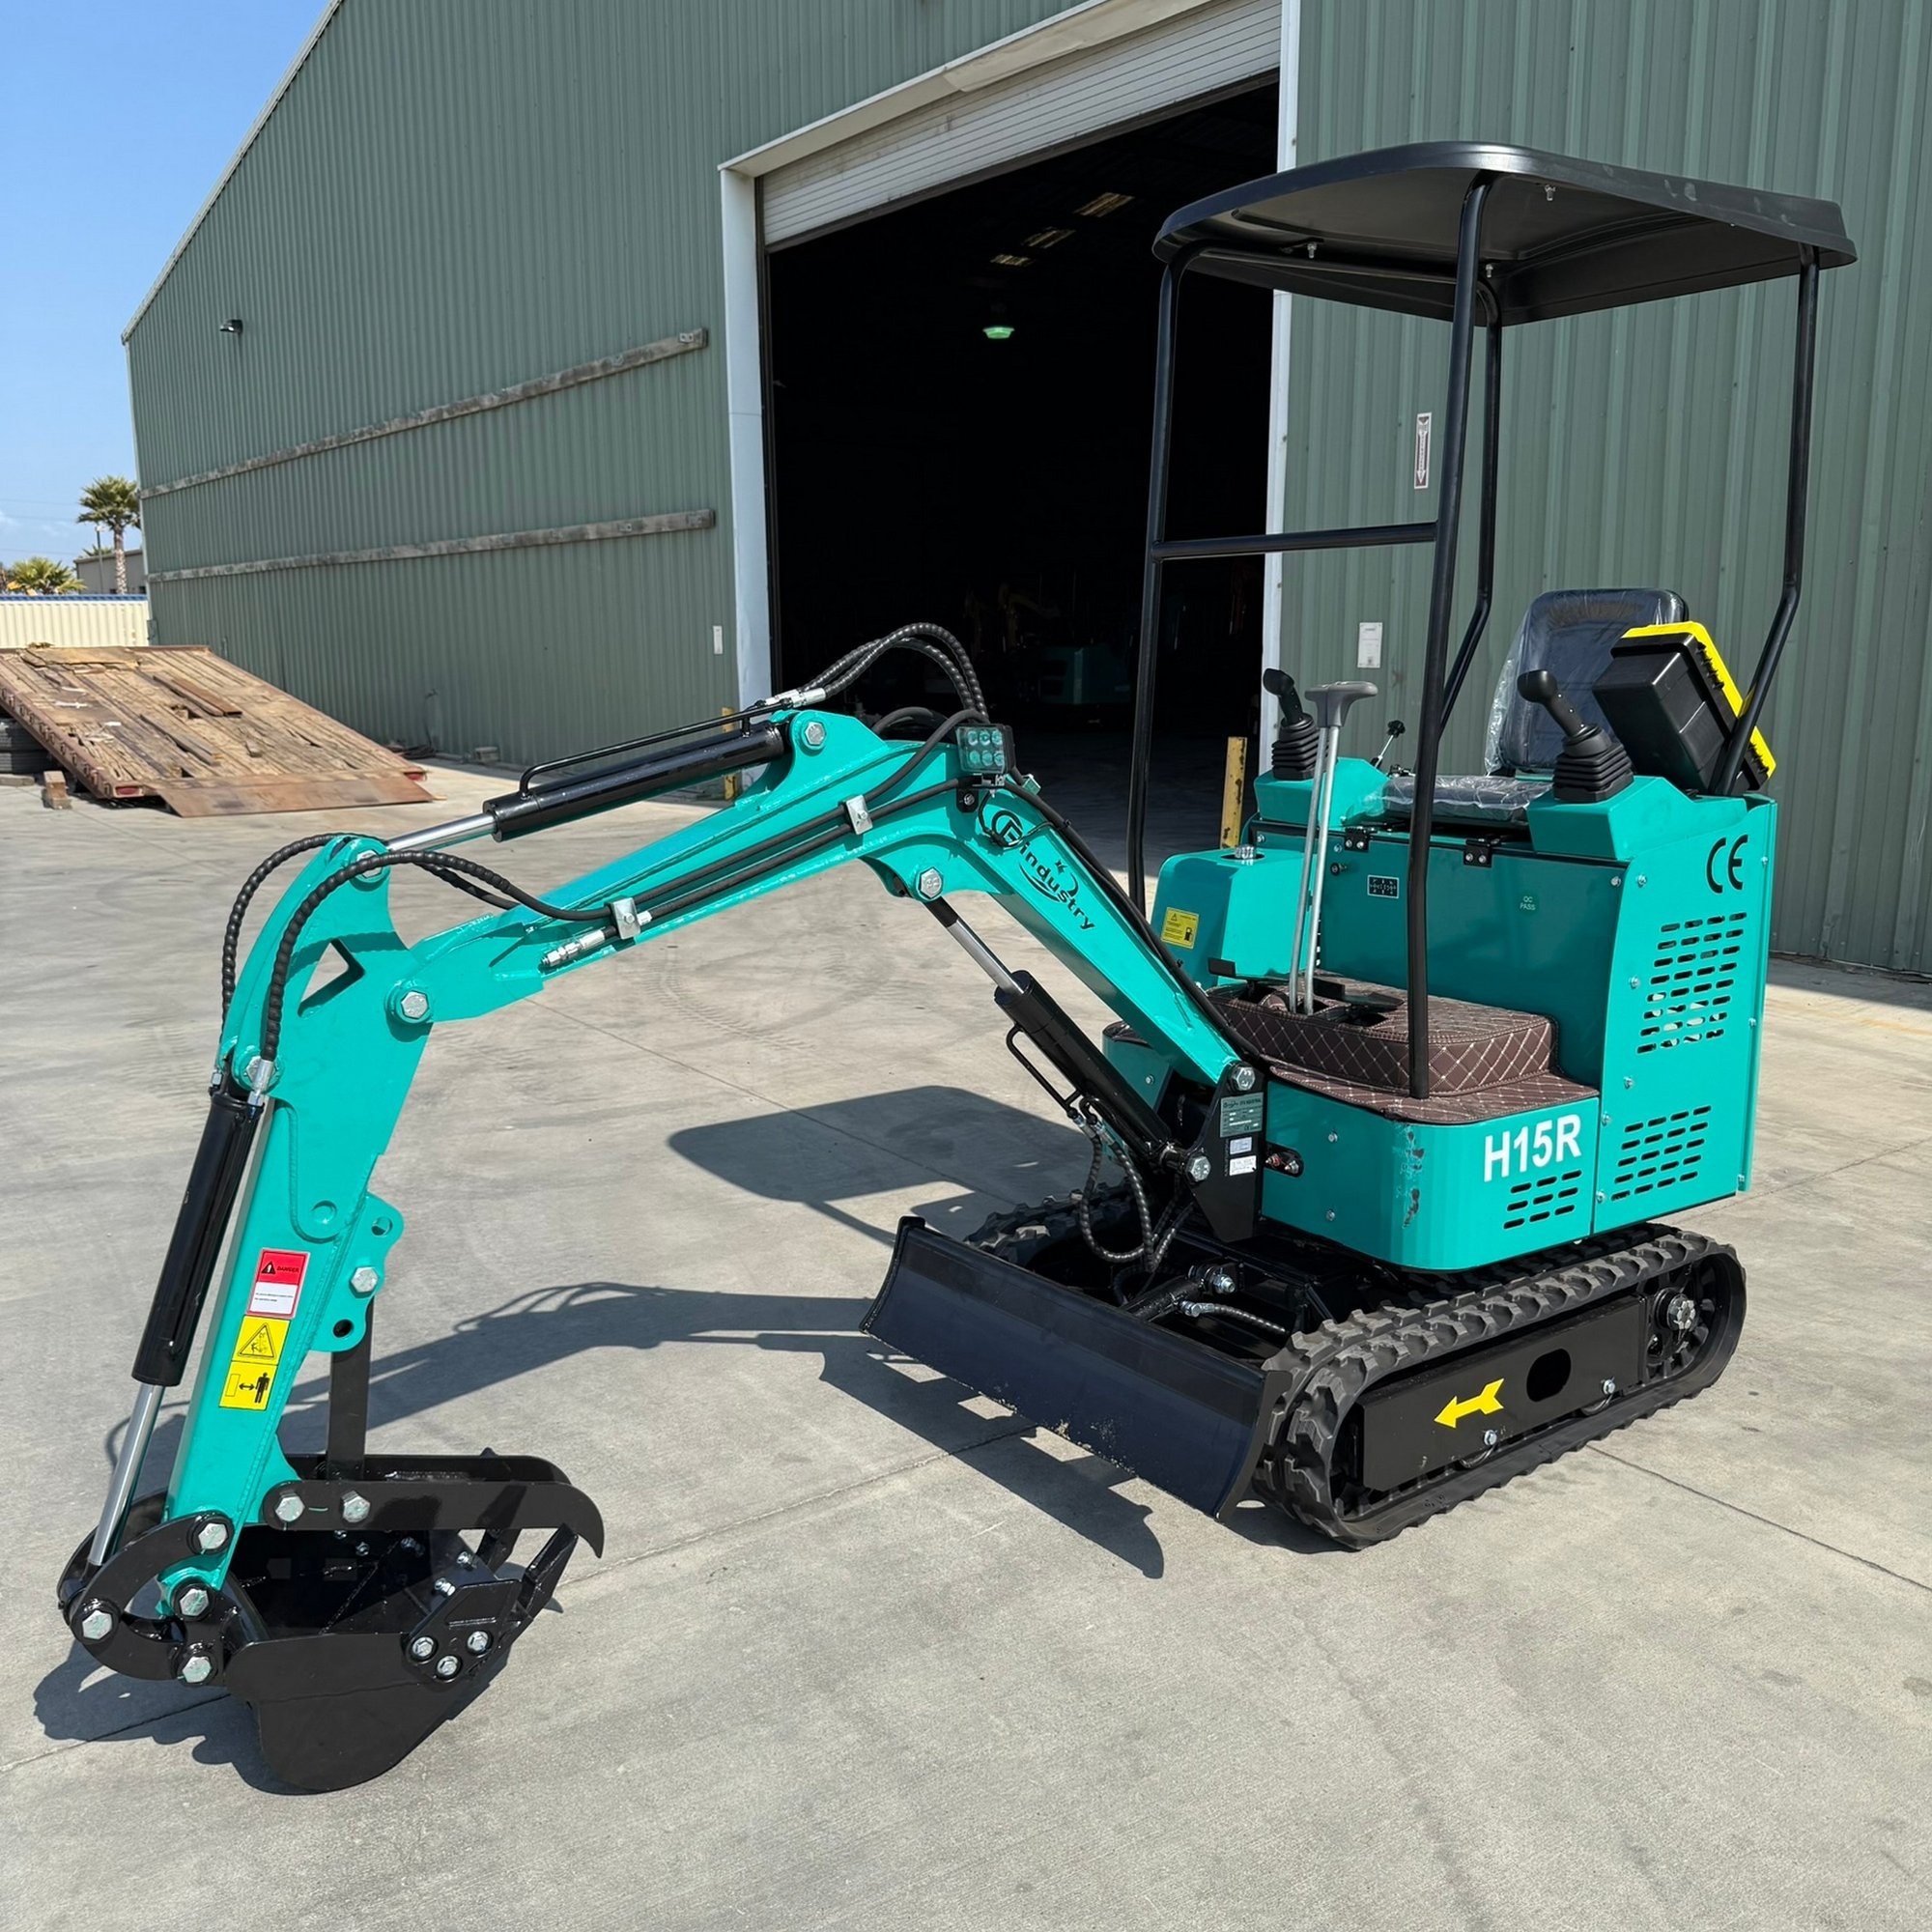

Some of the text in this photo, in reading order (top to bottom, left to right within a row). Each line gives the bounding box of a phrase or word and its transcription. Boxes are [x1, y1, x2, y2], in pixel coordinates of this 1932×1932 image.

[1019, 841, 1095, 930] industry
[1706, 834, 1749, 895] CE
[1520, 902, 1537, 911] PASS
[1484, 1114, 1582, 1182] H15R
